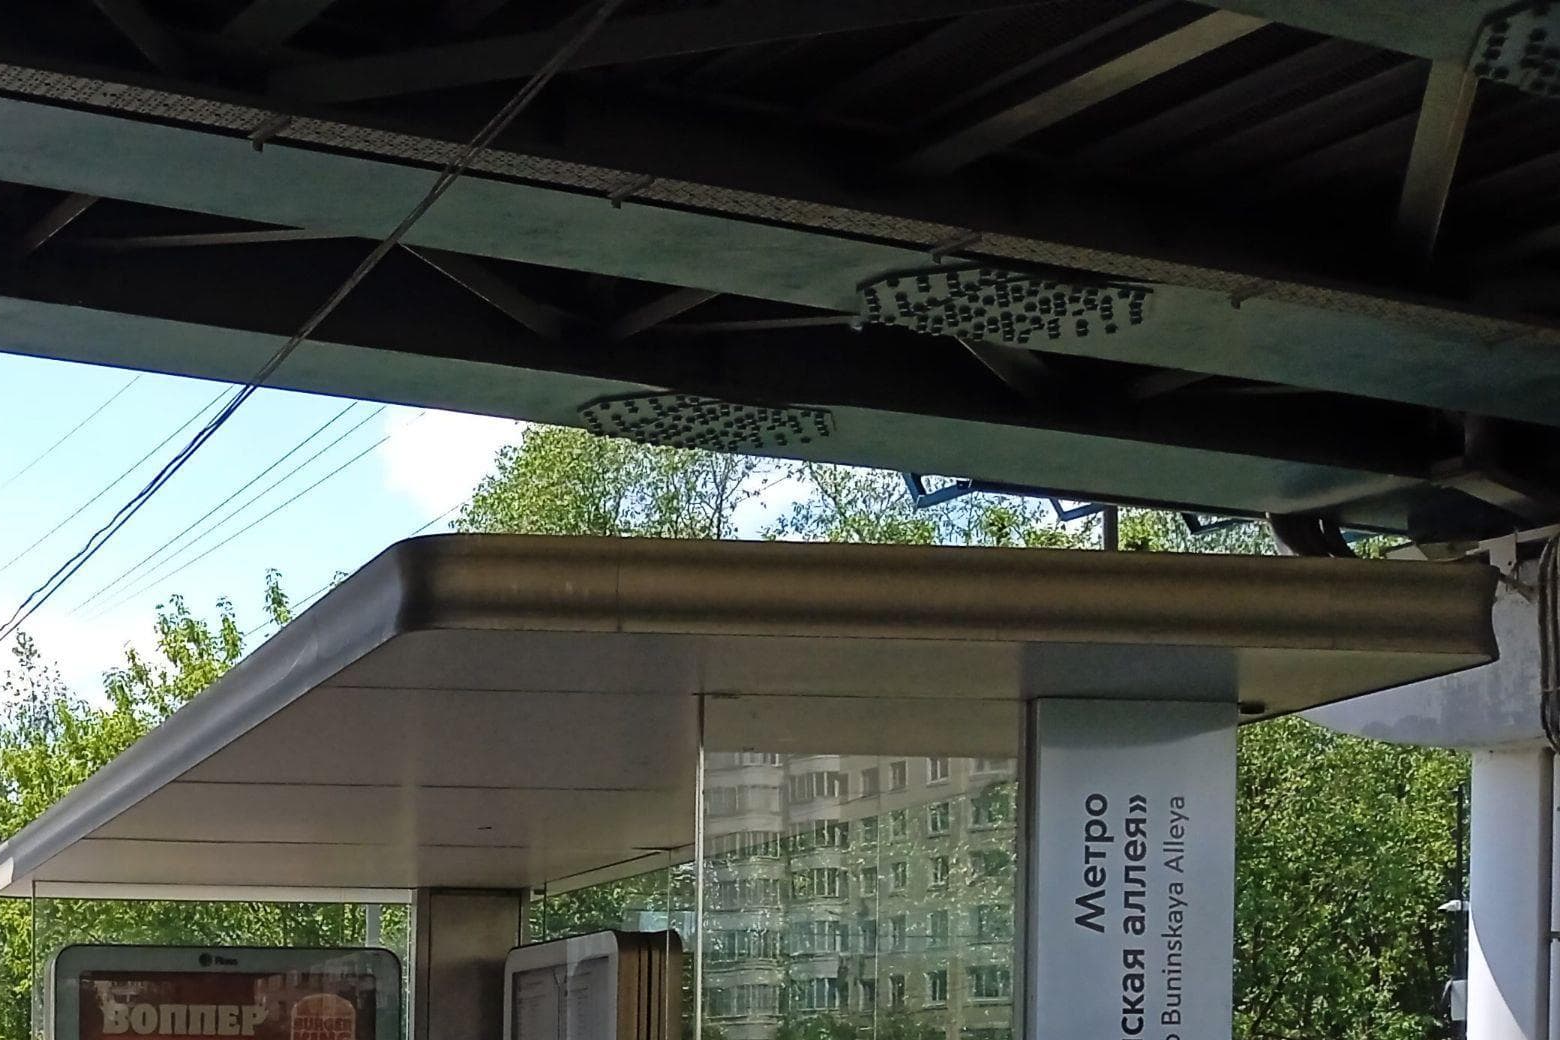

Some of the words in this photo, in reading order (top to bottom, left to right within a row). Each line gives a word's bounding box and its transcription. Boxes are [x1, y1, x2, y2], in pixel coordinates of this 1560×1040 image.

[1074, 793, 1115, 934] Метро
[1123, 794, 1148, 935] аллея»
[1163, 795, 1190, 873] Alleya
[1161, 882, 1188, 1026] Buninskaya
[102, 1003, 267, 1036] ВОППЕР
[294, 1017, 352, 1031] BURGER
